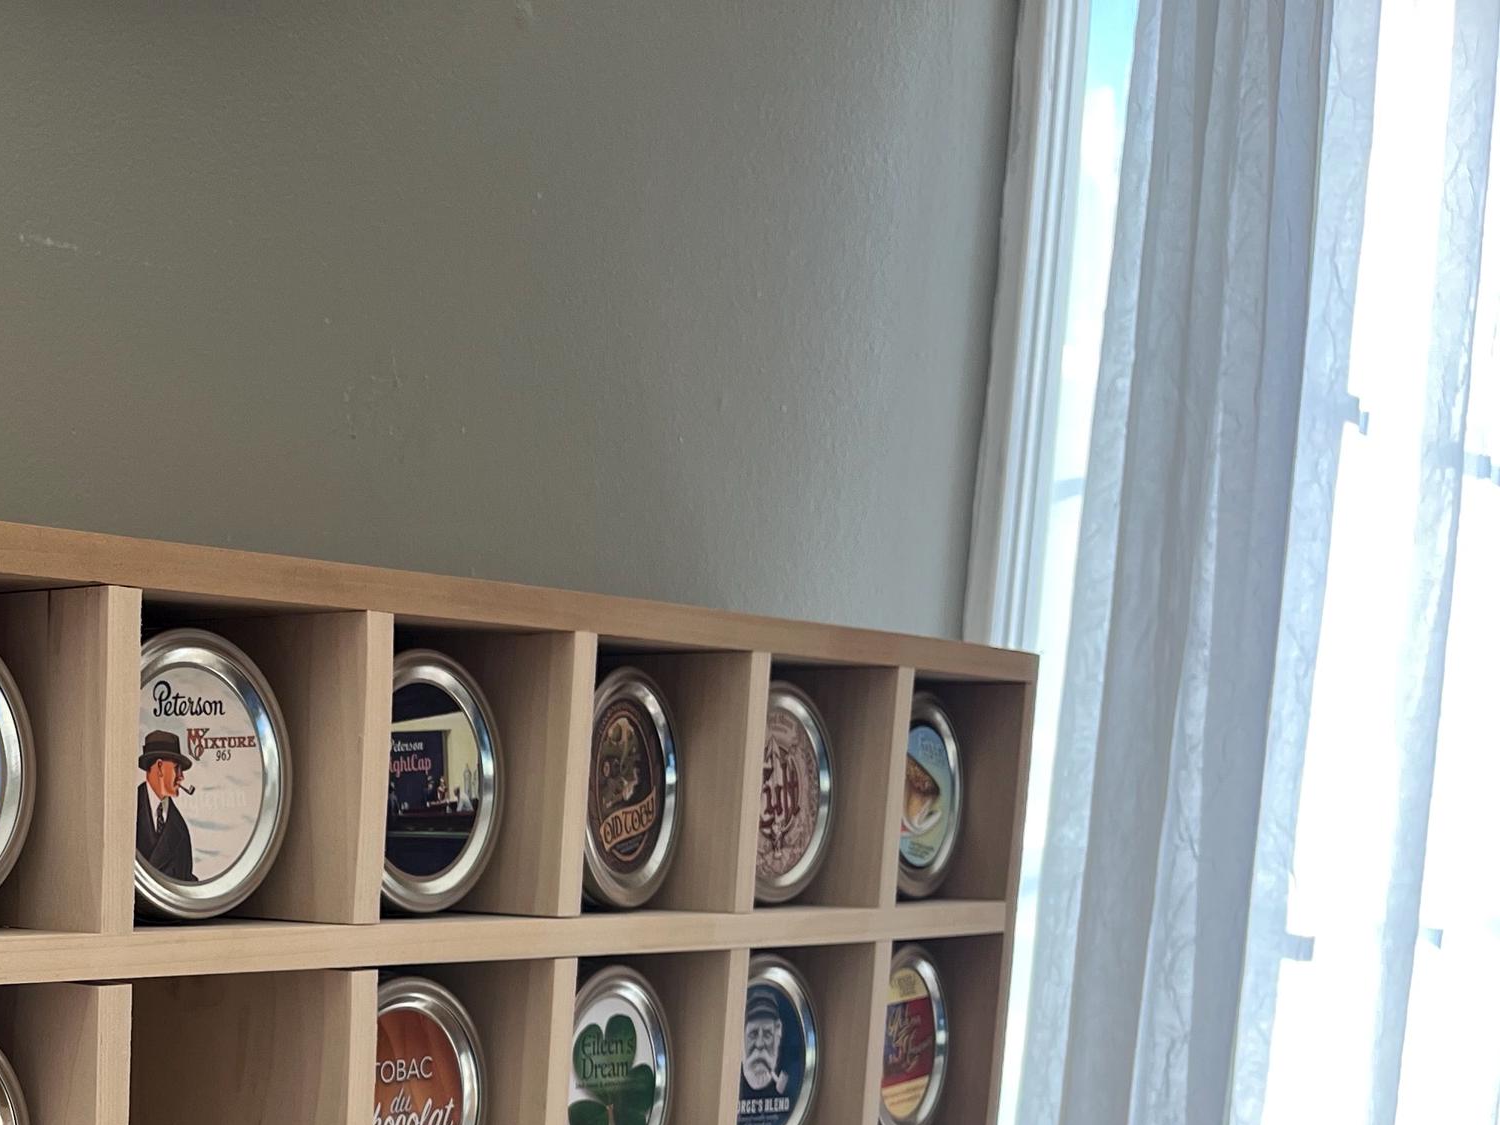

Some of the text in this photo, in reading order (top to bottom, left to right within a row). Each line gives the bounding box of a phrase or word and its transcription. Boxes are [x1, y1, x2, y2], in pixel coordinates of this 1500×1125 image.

[153, 680, 226, 718] Peterson
[216, 749, 231, 761] 965
[389, 753, 432, 778] ghtCap
[582, 1056, 629, 1080] Dream
[390, 1087, 412, 1113] du
[736, 1096, 790, 1115] RGE'S BLEND
